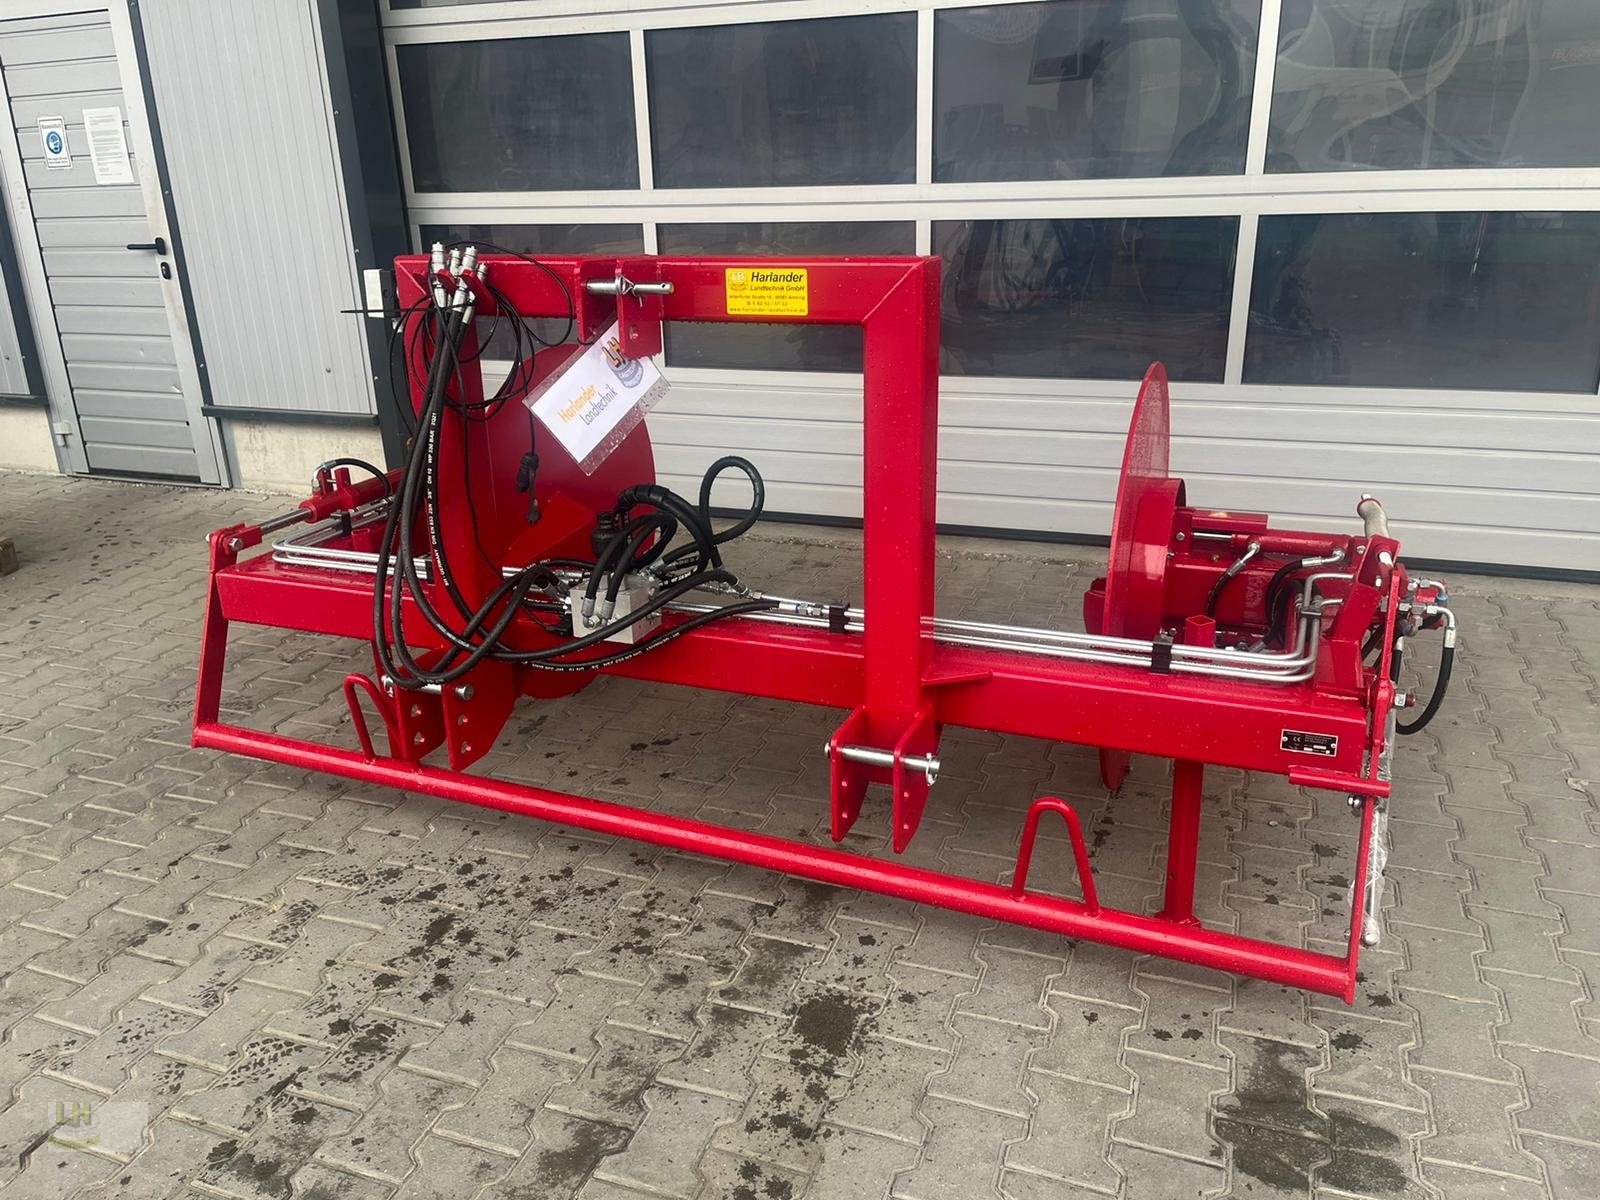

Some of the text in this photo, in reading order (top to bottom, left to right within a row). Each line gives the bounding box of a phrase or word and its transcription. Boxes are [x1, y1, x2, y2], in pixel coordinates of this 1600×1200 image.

[751, 271, 804, 282] Harlander
[601, 336, 623, 368] LH
[558, 384, 597, 423] Harlander
[579, 384, 618, 426] Landtechnik
